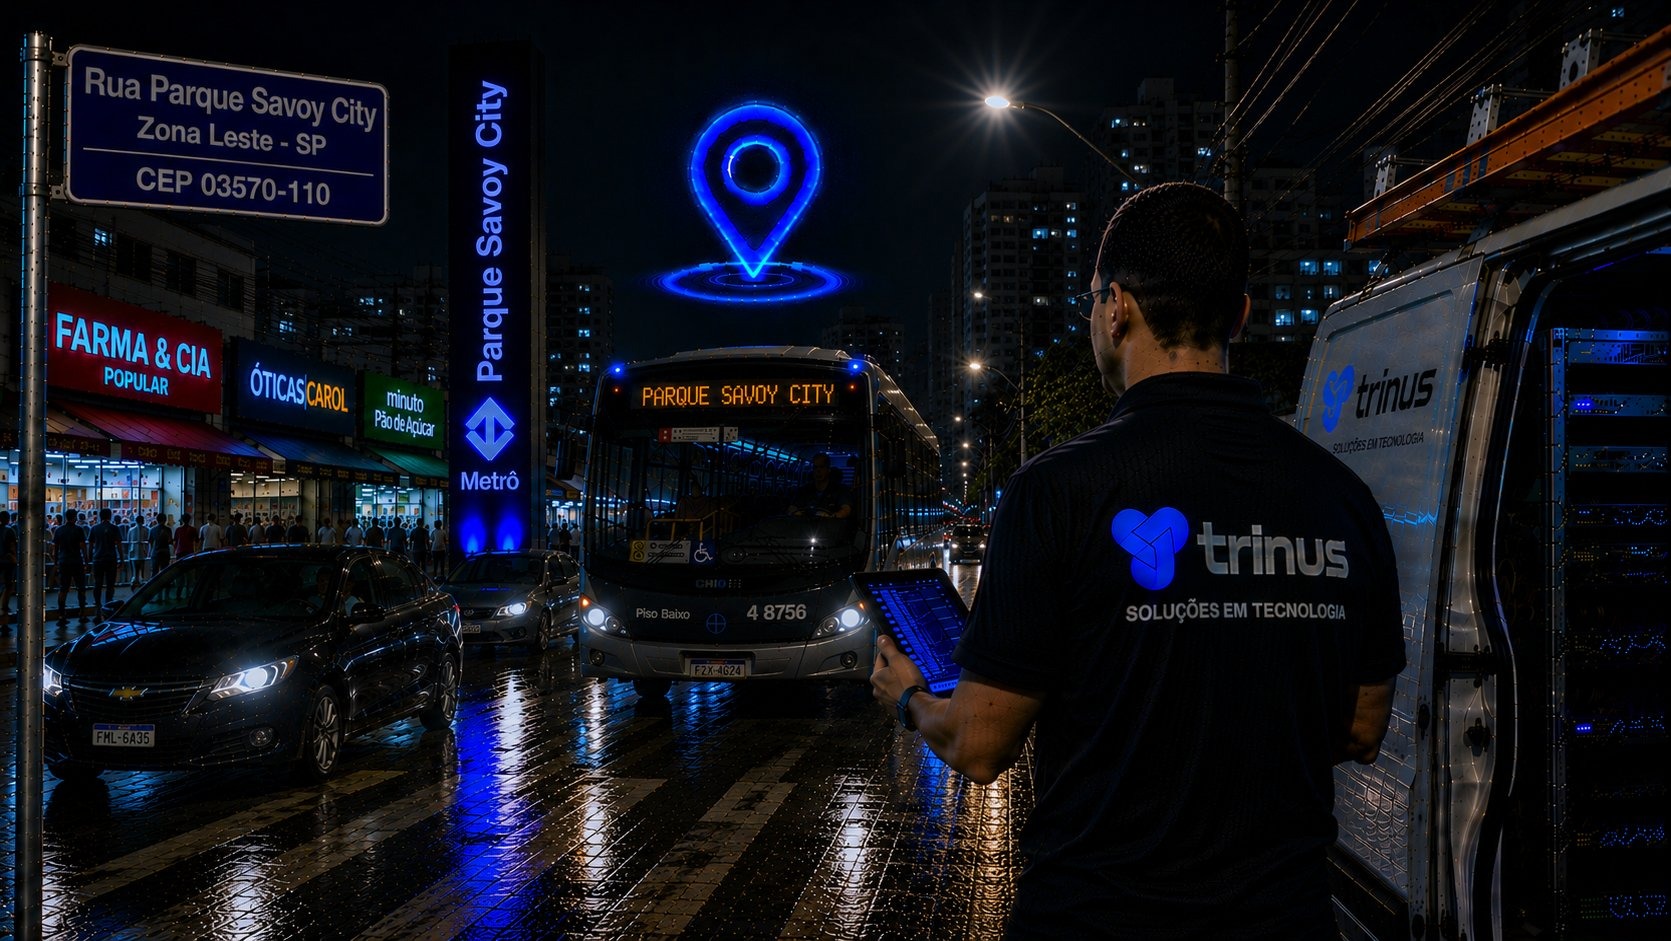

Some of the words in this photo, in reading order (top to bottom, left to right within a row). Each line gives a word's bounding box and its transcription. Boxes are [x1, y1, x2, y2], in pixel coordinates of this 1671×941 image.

[84, 66, 141, 100] Rua
[150, 74, 244, 115] Parque
[251, 87, 325, 127] Savoy
[331, 97, 377, 132] City
[475, 80, 507, 147] City
[137, 116, 201, 145] Zona
[209, 123, 273, 151] Leste
[295, 133, 327, 156] SP
[136, 167, 193, 194] CEP
[201, 173, 331, 206] 03570-110
[475, 157, 508, 257] Savoy
[476, 266, 509, 382] Parque
[56, 311, 150, 366] FARMA
[154, 337, 172, 370] &
[176, 342, 212, 379] CIA
[104, 366, 169, 396] POPULAR
[250, 362, 305, 405] ÓTICAS
[306, 380, 349, 413] CAROL
[642, 386, 710, 407] PARQUE
[721, 384, 779, 405] SAVOY
[789, 384, 835, 404] CITY
[1355, 368, 1437, 418] trinus
[387, 390, 424, 413] minuto
[374, 409, 393, 432] Pão
[394, 413, 405, 431] de
[407, 416, 436, 438] Açúcar
[1367, 437, 1378, 450] EM
[461, 471, 520, 491] Metrô
[1197, 521, 1349, 578] trinus
[636, 608, 659, 619] Piso
[661, 609, 691, 620] Baixo
[746, 604, 759, 621] 4
[763, 604, 807, 621] 8756
[1125, 598, 1220, 623] SOLUÇÕES
[1223, 603, 1247, 619] EM
[1252, 602, 1346, 620] TECNOLOGIA
